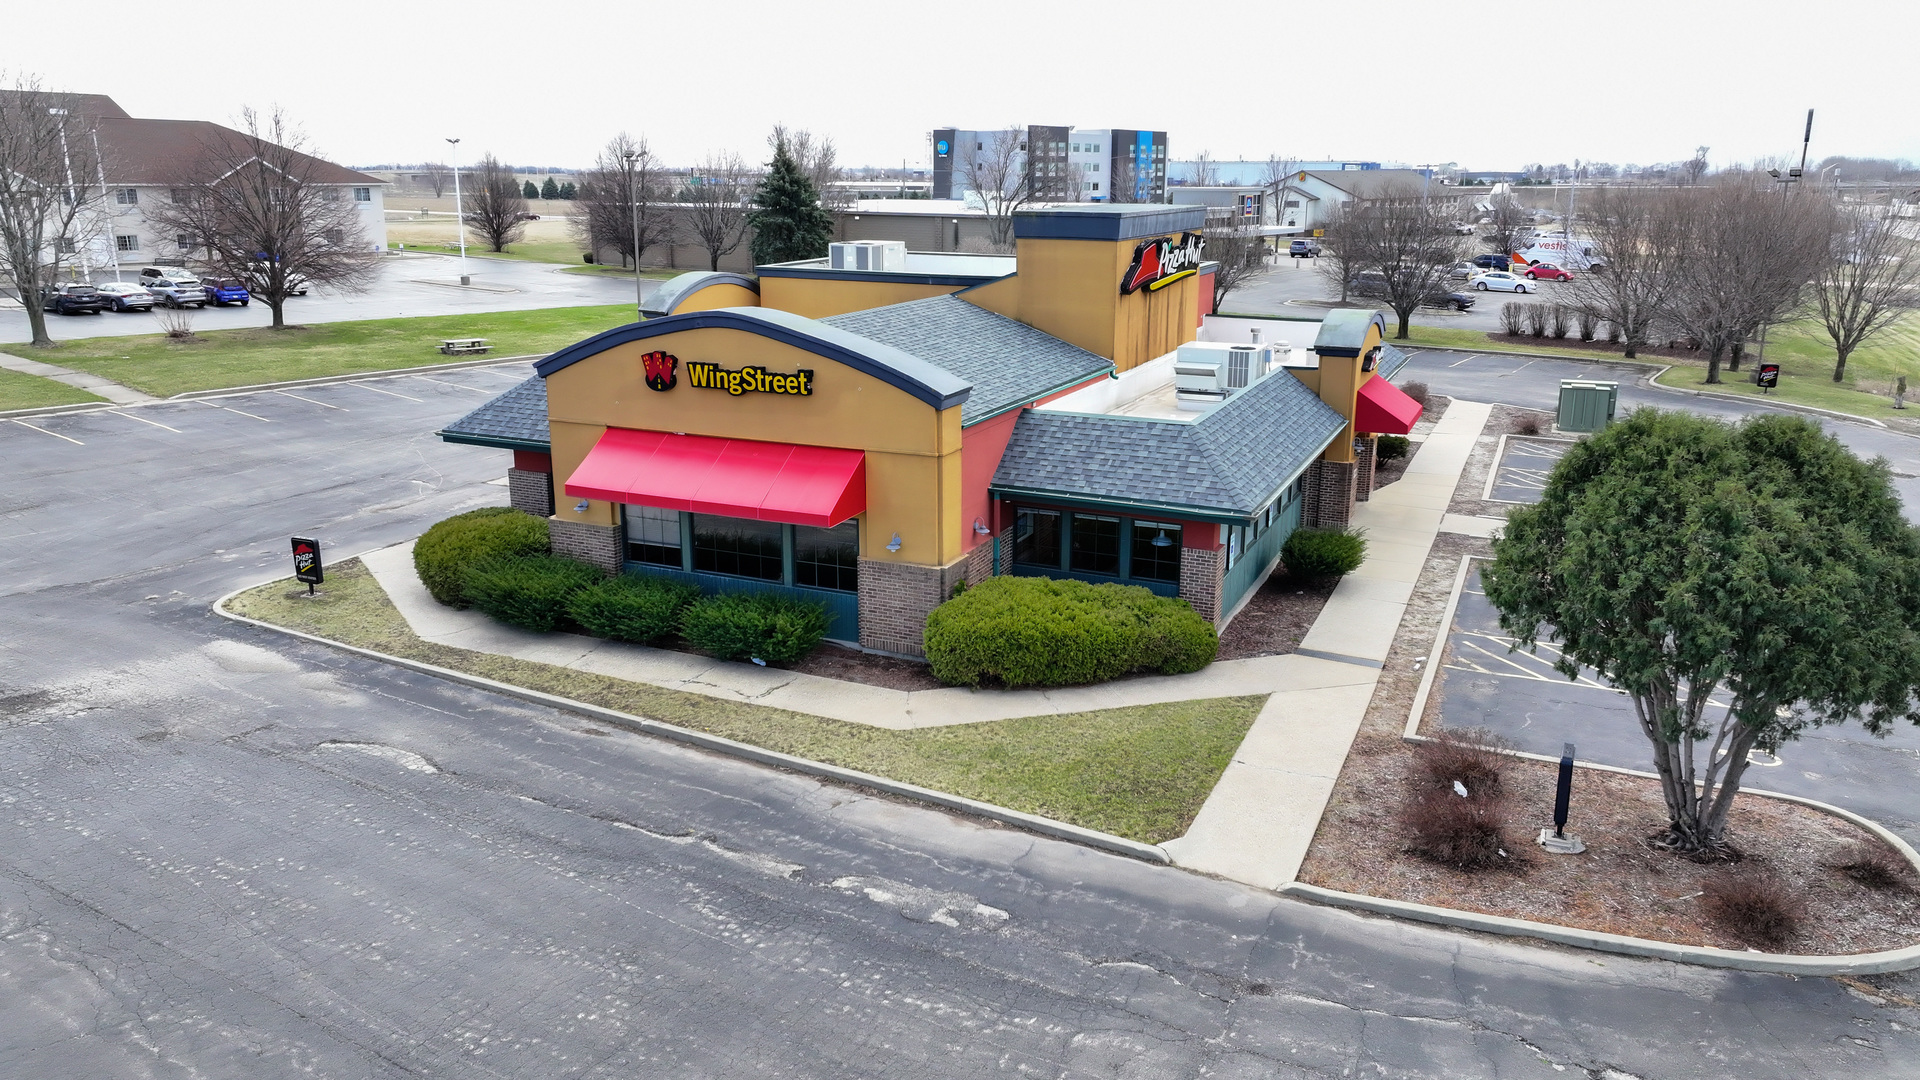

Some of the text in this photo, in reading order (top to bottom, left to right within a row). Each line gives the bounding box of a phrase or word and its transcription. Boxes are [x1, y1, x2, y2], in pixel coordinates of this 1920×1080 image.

[1157, 235, 1205, 279] Pizza Hut
[688, 362, 808, 396] WingStreet
[295, 552, 314, 566] Pizza
[299, 559, 313, 569] Hut
